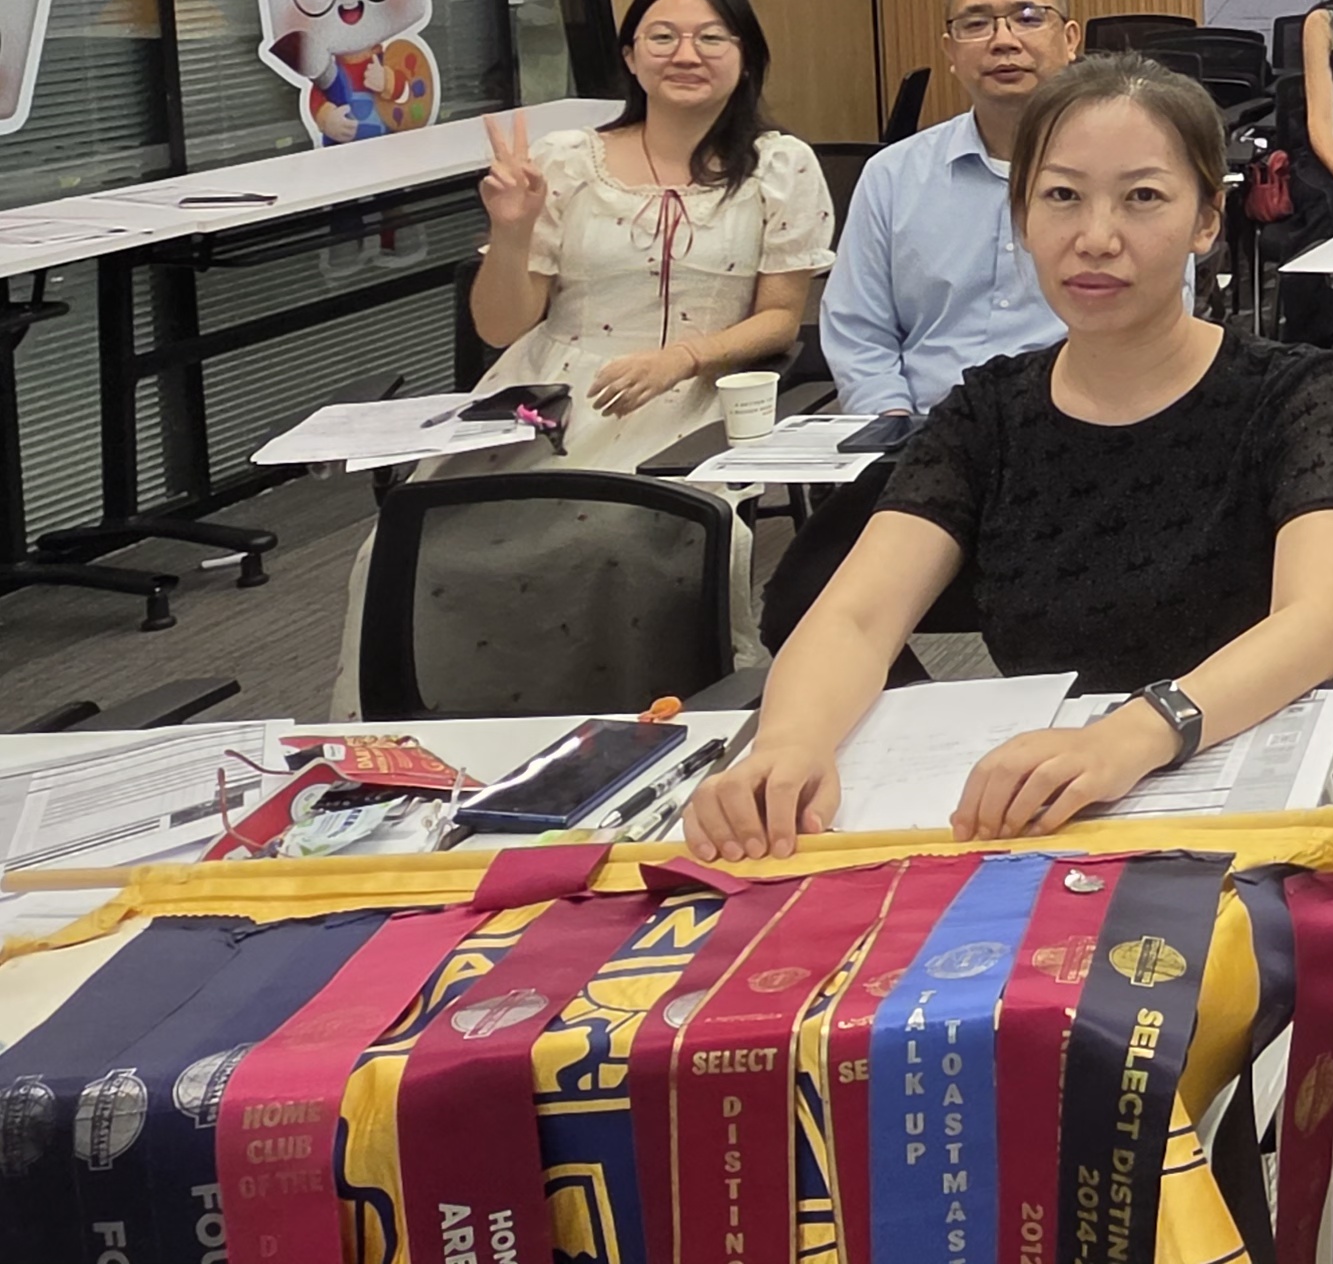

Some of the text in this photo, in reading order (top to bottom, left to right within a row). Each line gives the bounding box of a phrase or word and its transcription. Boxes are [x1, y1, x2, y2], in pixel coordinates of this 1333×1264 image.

[692, 1047, 778, 1076] SELECT
[1117, 1007, 1164, 1140] SELECT
[242, 1097, 324, 1131] HOME
[246, 1135, 312, 1165] CLUB
[905, 1112, 926, 1165] UP
[941, 1019, 969, 1264] TOASTMAS
[722, 1095, 745, 1264] DISTIN
[1107, 1148, 1134, 1264] DISTIN
